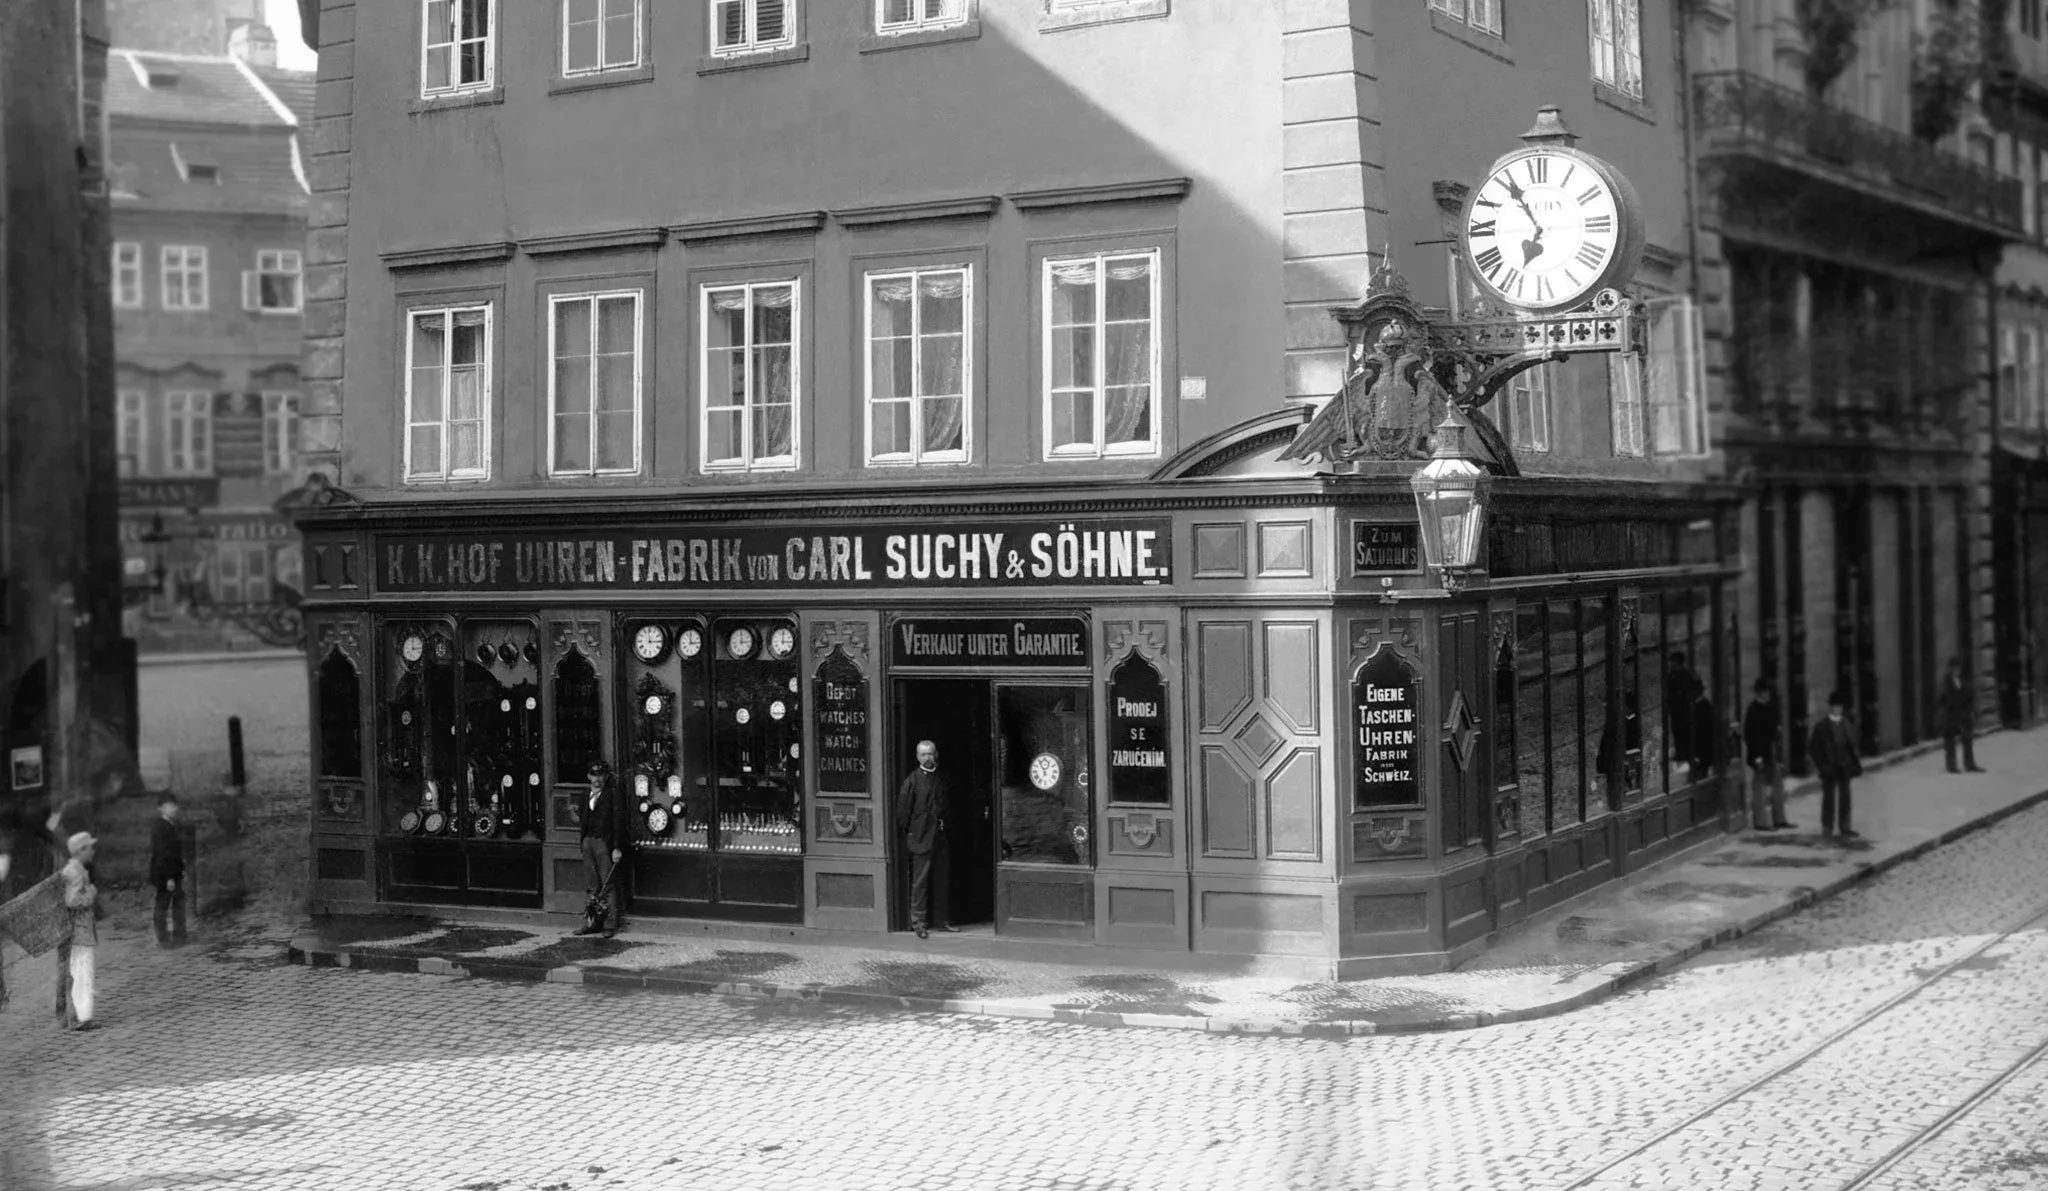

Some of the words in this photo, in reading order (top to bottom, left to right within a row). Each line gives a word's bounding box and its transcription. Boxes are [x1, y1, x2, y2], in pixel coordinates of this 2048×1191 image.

[1372, 528, 1402, 544] ZUM
[786, 536, 872, 582] CARL
[886, 532, 1004, 579] SUCHY
[1005, 549, 1025, 579] &
[1031, 524, 1169, 578] SÖHNE.
[1356, 541, 1416, 566] SATURNUS
[902, 624, 964, 655] VERKAUF
[967, 633, 1008, 655] UNTER
[1014, 622, 1084, 655] GARANTIE.
[1366, 683, 1405, 703] EIGENE
[1117, 697, 1157, 717] PRODEJ
[820, 710, 865, 724] WATCHES
[825, 735, 859, 748] WATCH
[1130, 727, 1146, 740] SE
[1366, 747, 1408, 761] FABRIK
